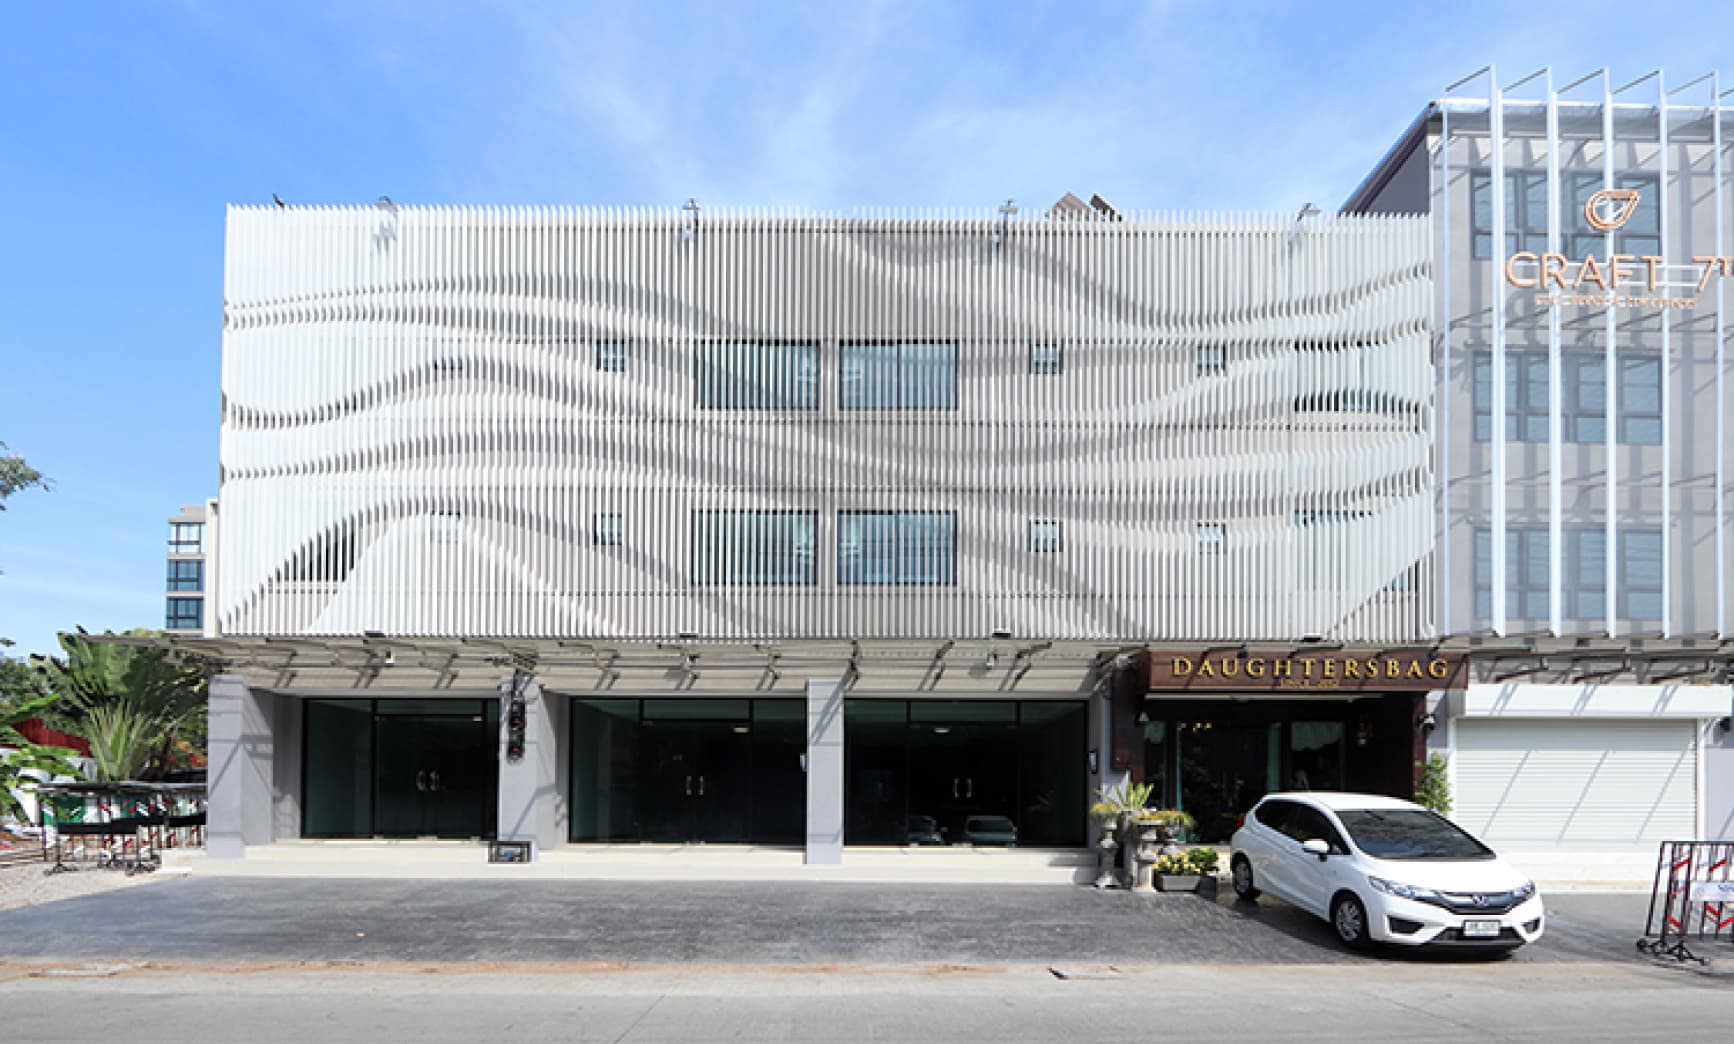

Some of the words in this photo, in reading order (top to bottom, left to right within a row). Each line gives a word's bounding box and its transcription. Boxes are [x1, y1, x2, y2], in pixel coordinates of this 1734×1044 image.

[1506, 251, 1664, 292] CRAFT
[1692, 255, 1734, 293] 7T
[1172, 656, 1448, 678] DAUGHTERSBAG
